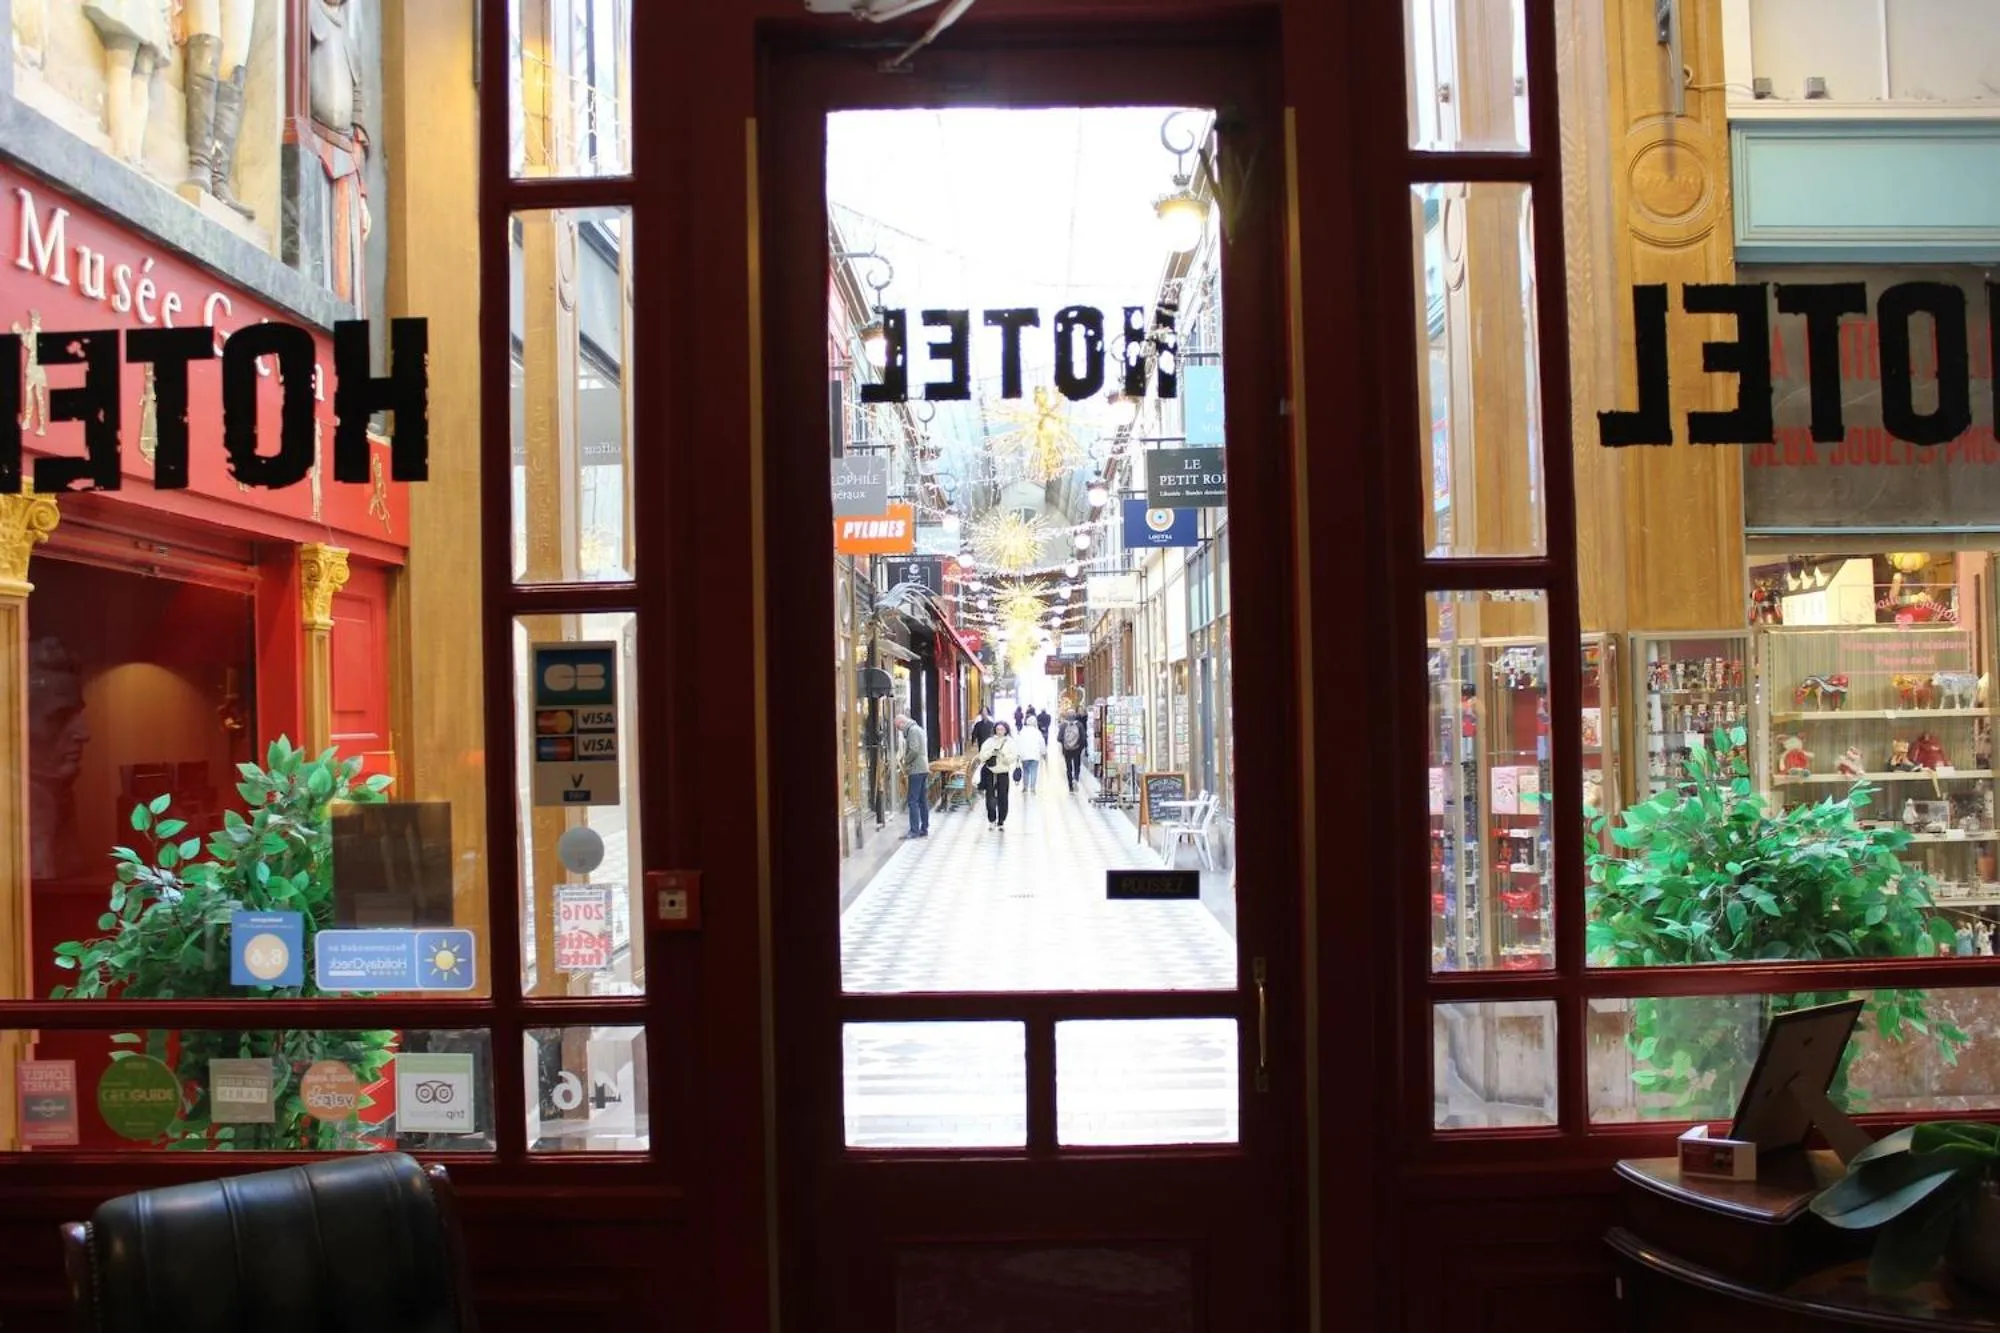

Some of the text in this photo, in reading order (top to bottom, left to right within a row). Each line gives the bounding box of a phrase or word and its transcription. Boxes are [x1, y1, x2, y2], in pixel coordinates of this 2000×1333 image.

[15, 187, 182, 328] Musée
[1184, 459, 1201, 470] LE
[1159, 474, 1199, 486] PETIT
[843, 521, 905, 539] PYLONES
[582, 713, 613, 724] VISA
[583, 740, 613, 751] VISA
